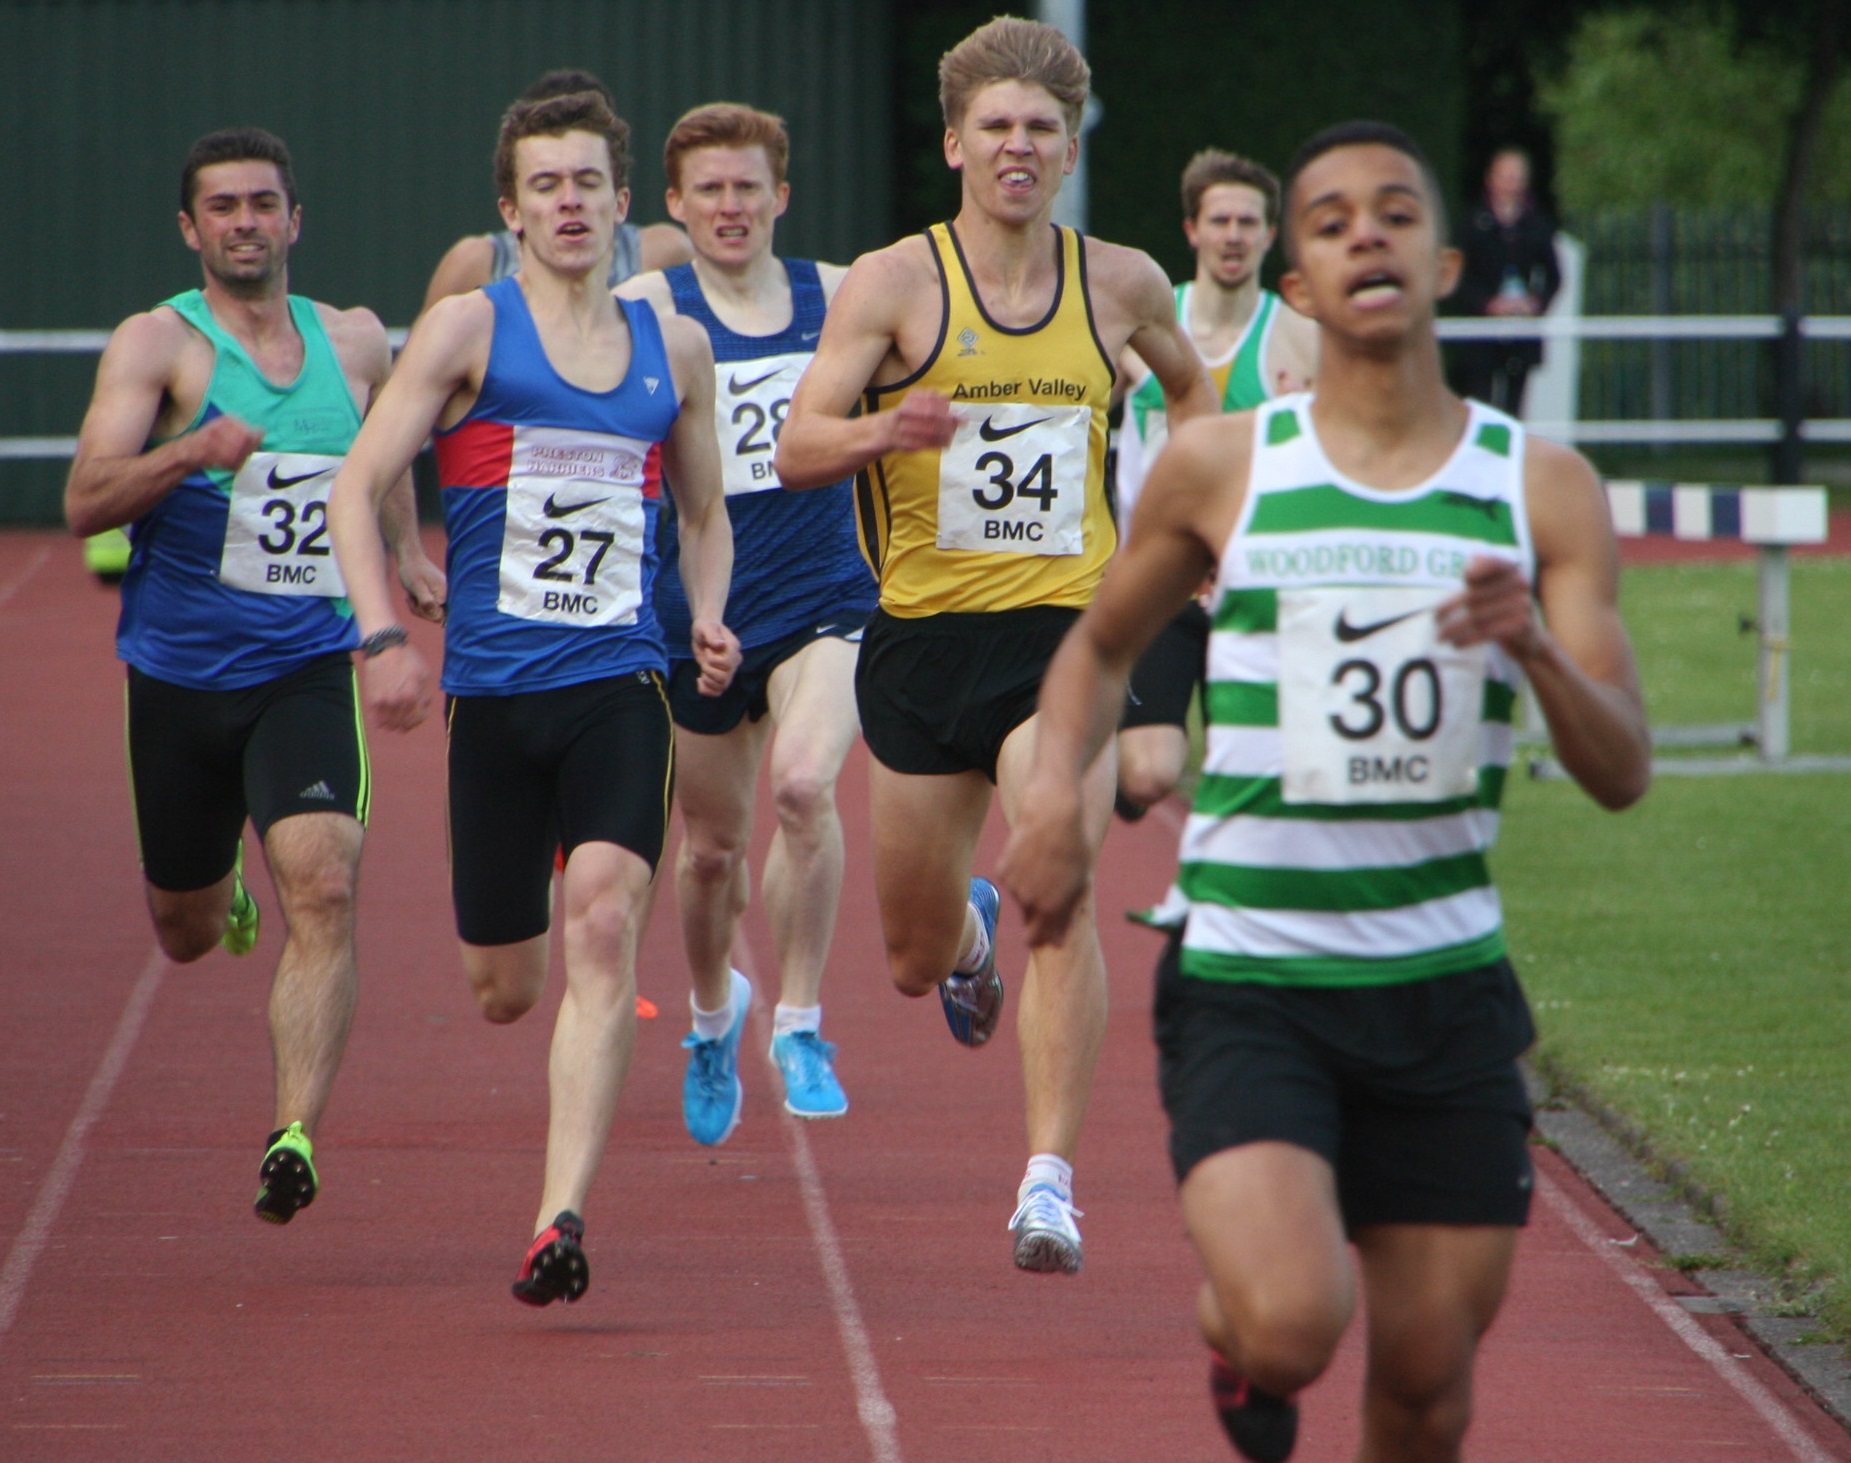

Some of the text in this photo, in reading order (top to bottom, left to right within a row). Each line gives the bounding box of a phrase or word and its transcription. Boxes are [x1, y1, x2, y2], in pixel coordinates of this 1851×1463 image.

[953, 378, 1086, 401] Amber Valley
[972, 451, 1058, 512] 34
[258, 499, 331, 556] 32
[984, 520, 1044, 542] BMC
[533, 528, 615, 585] 27
[1247, 544, 1418, 577] WOODFORD
[266, 564, 317, 584] BMC
[543, 591, 598, 615] BMC
[1329, 658, 1442, 741] 30
[1347, 755, 1429, 784] BMC
